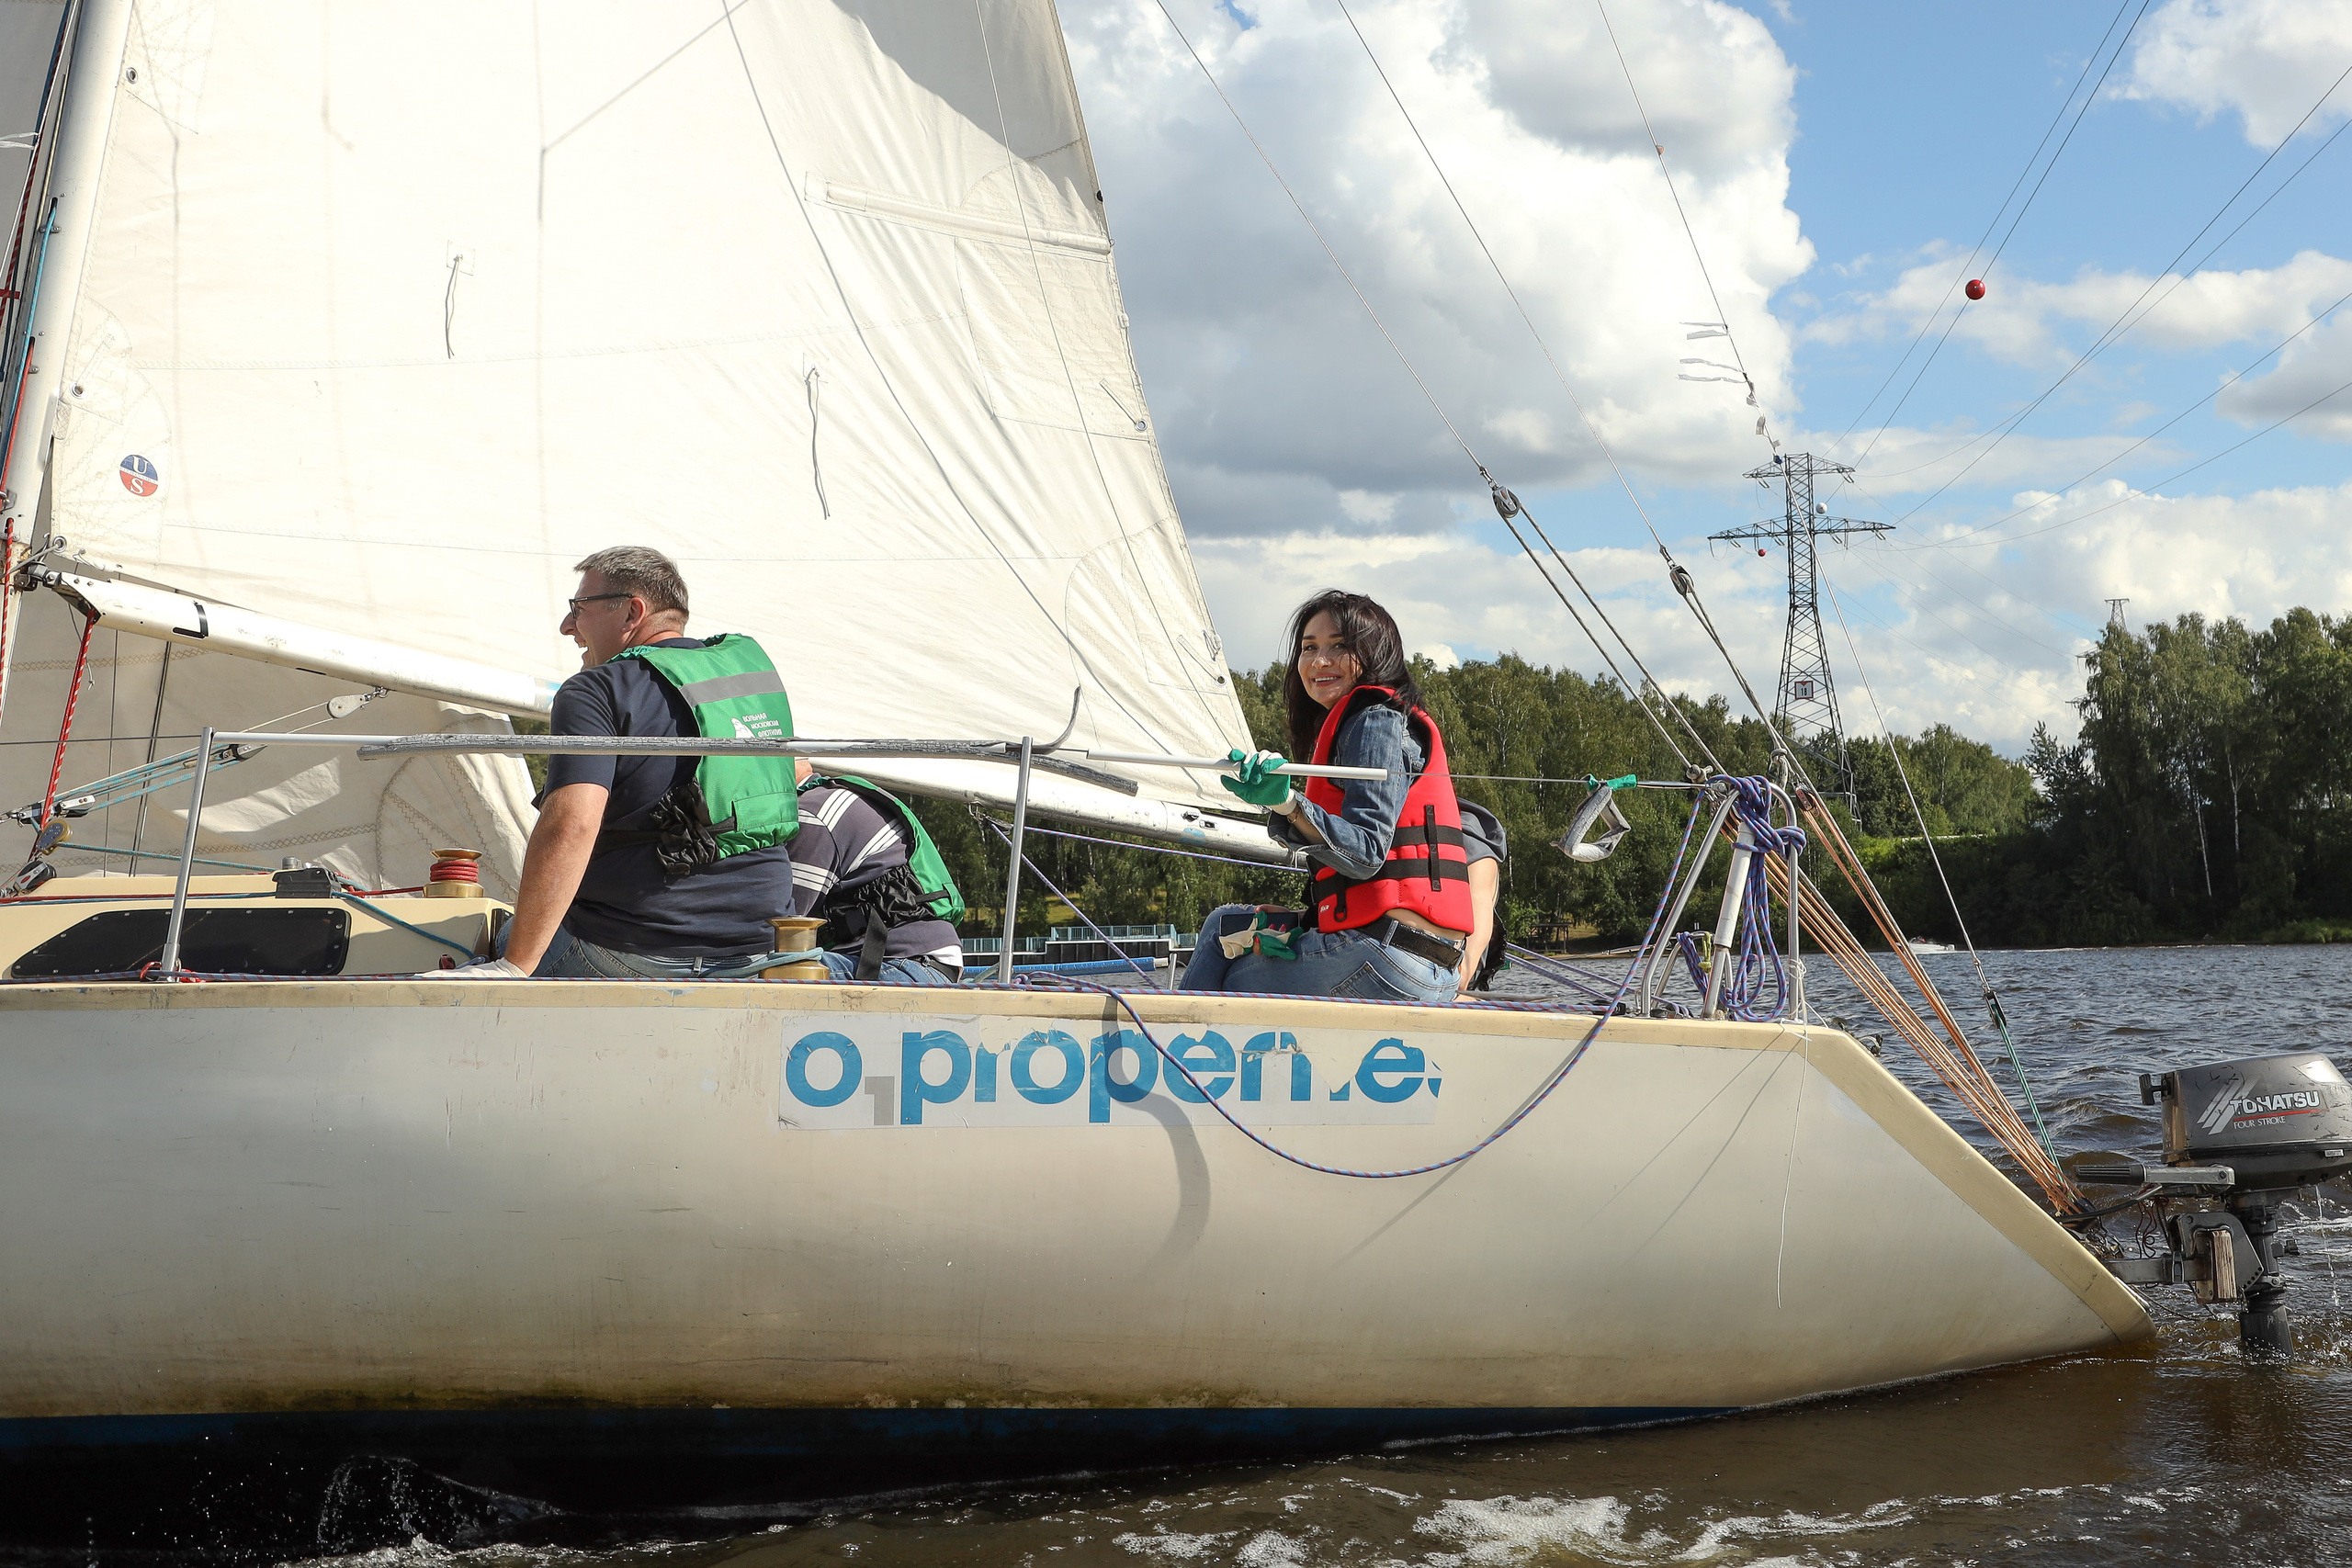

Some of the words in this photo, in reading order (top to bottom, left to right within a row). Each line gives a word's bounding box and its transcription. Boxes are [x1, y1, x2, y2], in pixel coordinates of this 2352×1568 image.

[742, 713, 767, 723] ВОЛЬНАЯ
[2229, 1090, 2321, 1115] TOHATSU
[2233, 1121, 2256, 1130] FOUR
[2258, 1116, 2286, 1127] STROKE
